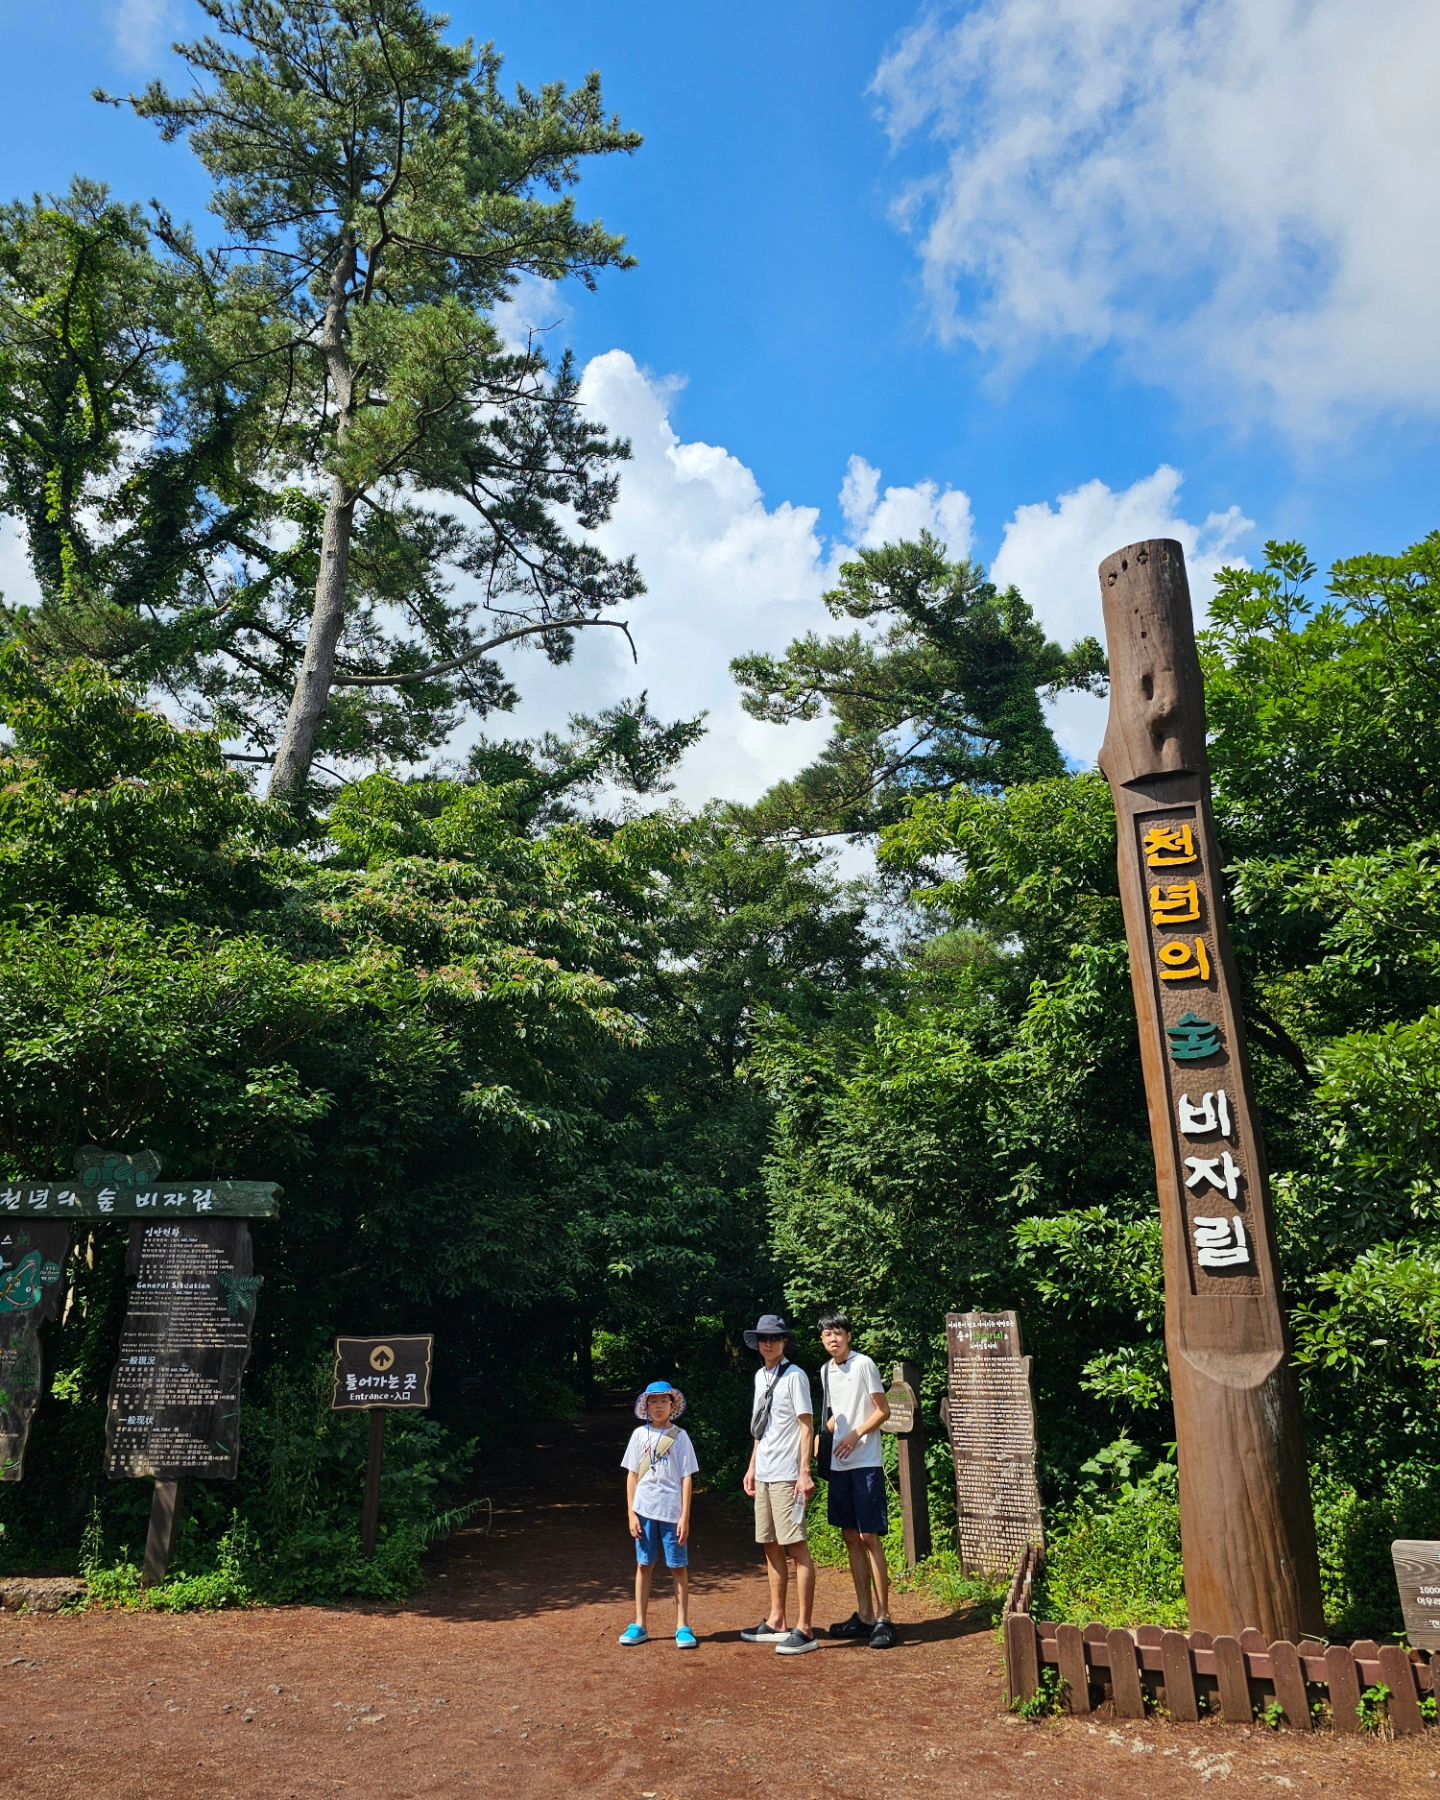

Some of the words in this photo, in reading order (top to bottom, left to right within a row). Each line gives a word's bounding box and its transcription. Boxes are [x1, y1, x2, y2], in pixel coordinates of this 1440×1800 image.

[1143, 823, 1211, 981] 천년의
[1167, 1011, 1221, 1060] 숲
[1179, 1089, 1250, 1267] 비자림
[0, 1187, 76, 1211] 천년의
[97, 1187, 117, 1213] 숲
[135, 1189, 213, 1213] 비자림
[136, 1281, 169, 1289] General
[171, 1281, 211, 1289] Situation
[345, 1373, 399, 1391] 들어가는
[403, 1373, 417, 1390] 곳
